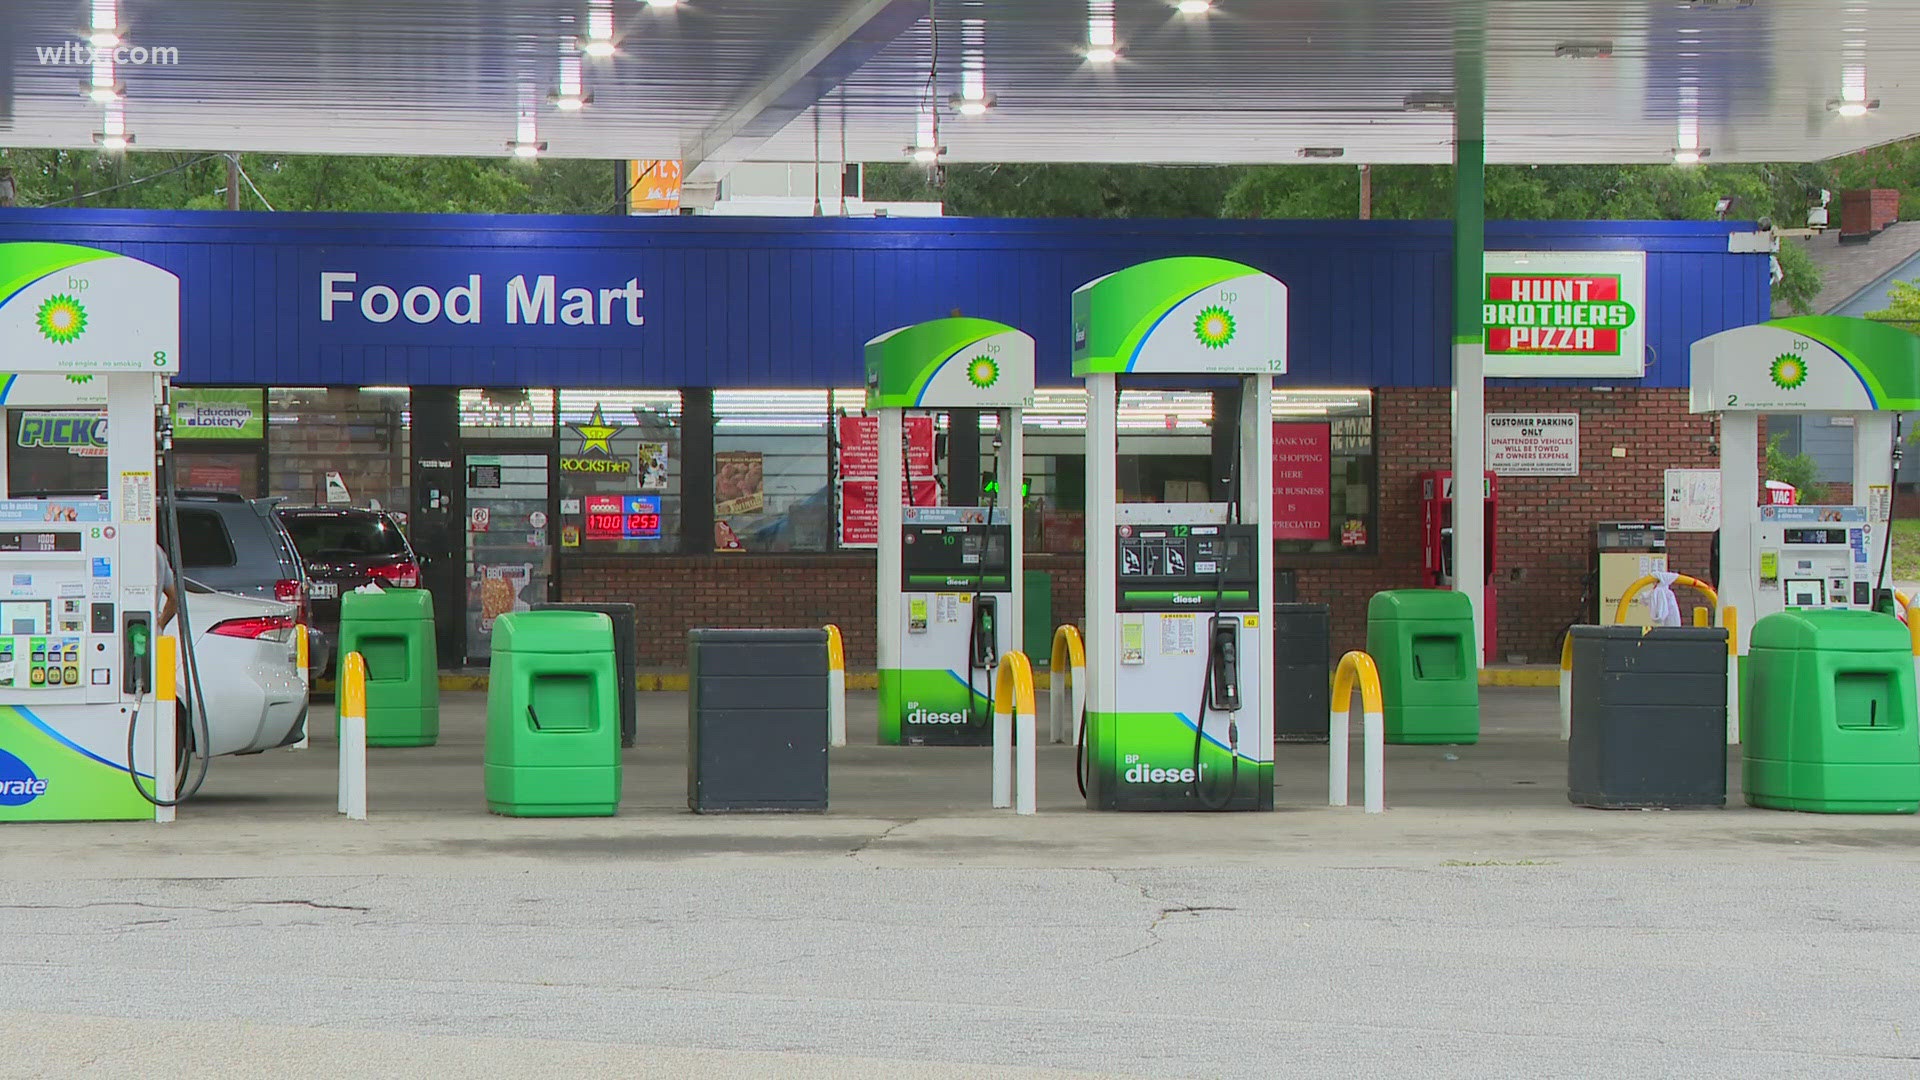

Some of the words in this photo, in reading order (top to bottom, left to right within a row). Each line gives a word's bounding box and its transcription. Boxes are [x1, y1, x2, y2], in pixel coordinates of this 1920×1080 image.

[68, 275, 89, 292] bp
[1220, 289, 1237, 304] bp
[1511, 280, 1593, 302] HUNT
[320, 271, 481, 324] Food
[506, 274, 644, 326] Mart
[1483, 304, 1627, 325] BROTHERS
[1510, 327, 1594, 349] PIZZA
[987, 342, 1000, 354] bp
[1793, 340, 1809, 351] bp
[153, 351, 167, 366] 8
[1268, 360, 1282, 371] 12
[1023, 397, 1033, 407] 10
[1727, 394, 1738, 406] 2
[197, 408, 252, 417] Education
[197, 416, 246, 428] Lottery
[1491, 418, 1534, 426] CUSTOMER
[1537, 418, 1574, 426] PARKING
[22, 419, 91, 443] PICK
[1521, 428, 1543, 436] ONLY
[1272, 437, 1298, 445] HANK
[1299, 437, 1317, 445] YOU
[1279, 454, 1322, 462] SHOPPING
[1772, 491, 1790, 503] VAC
[91, 527, 100, 538] 8
[1172, 526, 1188, 537] 12
[942, 535, 955, 545] 10
[1864, 536, 1870, 544] 2
[1173, 595, 1201, 603] diesel
[907, 701, 919, 709] BP
[907, 709, 967, 725] diesel
[1125, 754, 1139, 764] BP
[1125, 763, 1203, 783] diesel
